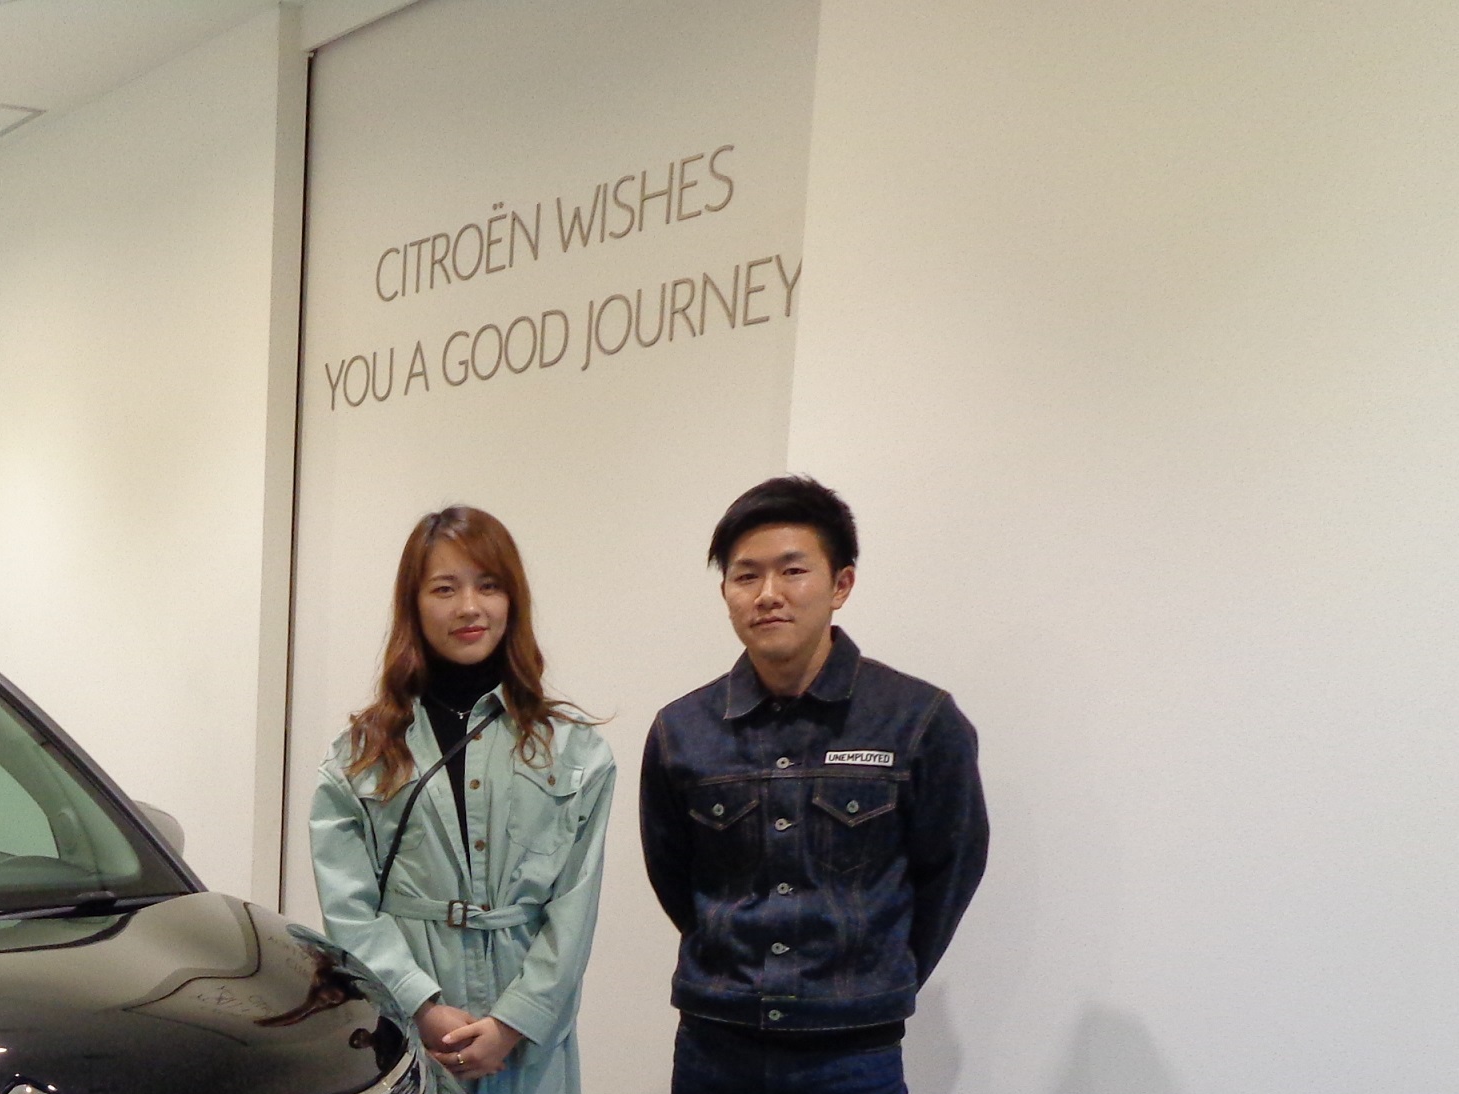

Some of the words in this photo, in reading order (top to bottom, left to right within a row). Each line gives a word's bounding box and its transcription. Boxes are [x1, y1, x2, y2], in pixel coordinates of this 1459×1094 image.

[376, 201, 541, 302] CITROËN
[556, 144, 736, 253] WISHES
[324, 347, 395, 411] YOU
[404, 340, 431, 397] A
[442, 309, 570, 387] GOOD
[581, 254, 804, 372] JOURNEY
[828, 753, 891, 763] UNEMPLOYED
